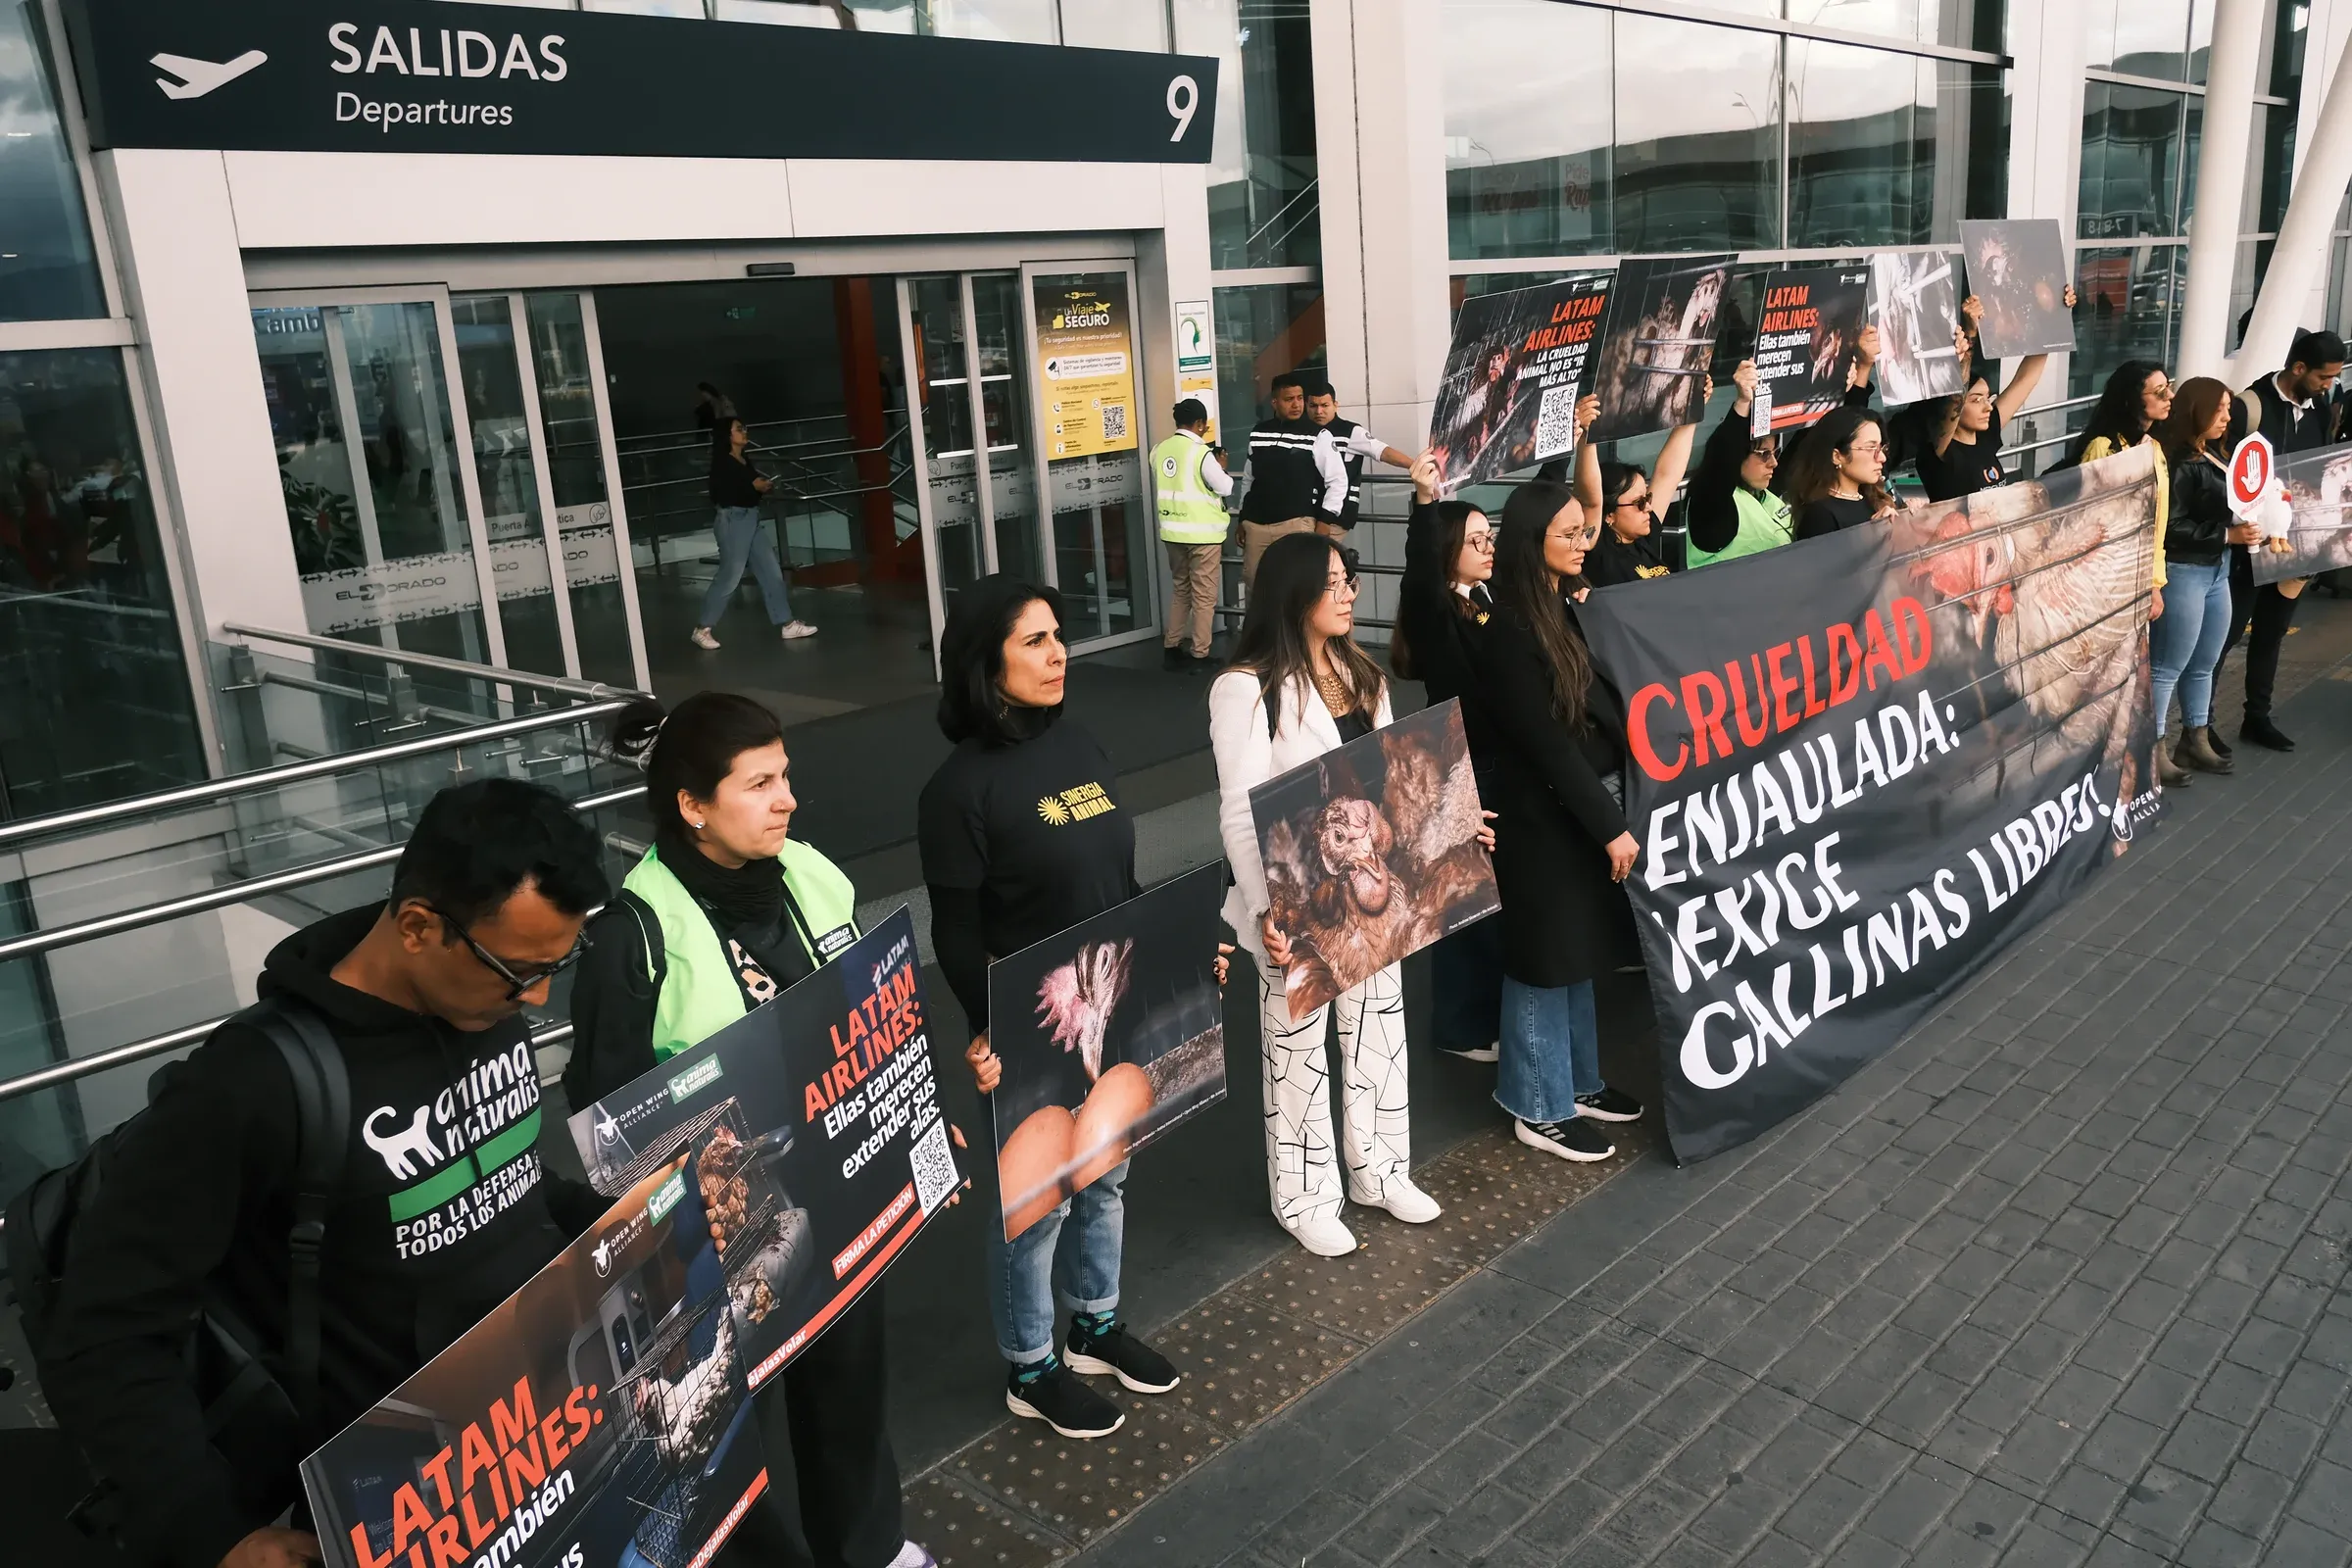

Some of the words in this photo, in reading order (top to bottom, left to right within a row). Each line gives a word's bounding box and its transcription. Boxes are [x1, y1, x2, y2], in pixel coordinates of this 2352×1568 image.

[328, 22, 568, 82] SALIDAS
[336, 91, 514, 133] Departures
[1166, 74, 1199, 142] 9
[1072, 303, 1094, 316] Viaje
[1551, 295, 1605, 323] LATAM
[1766, 285, 1809, 309] LATAM
[1065, 314, 1109, 328] SEGURO
[1523, 320, 1595, 352] AIRLINES:
[1761, 308, 1819, 332] AIRLINES:
[1537, 351, 1547, 364] LA
[1548, 343, 1589, 361] CRUELDAD
[1759, 334, 1778, 351] Ellas
[1778, 331, 1811, 348] también
[1516, 365, 1548, 381] ANIMAL
[1549, 362, 1563, 374] NO
[1564, 360, 1573, 370] ES
[1756, 364, 1790, 380] extender
[1790, 363, 1804, 375] sus
[1757, 350, 1791, 366] merecen
[1755, 381, 1772, 396] alas.
[492, 521, 521, 533] Puerta
[1627, 596, 1933, 782] CRUELDAD
[1059, 782, 1105, 807] SINERGIA
[1643, 689, 1960, 892] ENJAULADA:
[2130, 791, 2155, 811] OPEN
[1069, 796, 1116, 821] ANIMAL
[2133, 803, 2161, 823] ALLIA
[881, 935, 909, 975] LATAM
[830, 962, 917, 1058] LATAM
[687, 1058, 716, 1084] anima
[805, 1001, 924, 1124] AIRLINES:
[435, 1041, 532, 1125] anima
[823, 1093, 866, 1141] Ellas
[865, 1034, 928, 1102] también
[868, 1054, 932, 1129] merecen
[445, 1074, 540, 1157] naturalis
[619, 1103, 644, 1122] OPEN
[645, 1088, 669, 1105] WING
[623, 1102, 661, 1130] ALLIANCE
[909, 1099, 941, 1142] alas.
[842, 1102, 911, 1180] extender
[912, 1075, 937, 1112] sus
[396, 1212, 443, 1243] POR
[449, 1196, 470, 1221] LA
[472, 1153, 533, 1204] DEFENSA
[660, 1174, 682, 1202] anima
[396, 1219, 467, 1260] TODOS
[468, 1201, 495, 1232] LOS
[611, 1226, 629, 1248] OPEN
[630, 1206, 649, 1229] WING
[613, 1225, 643, 1257] ALLIANCE
[834, 1242, 865, 1274] FIRMA
[862, 1227, 878, 1250] LA
[875, 1188, 912, 1235] PETICIÓN
[350, 1375, 538, 1568] LATAM
